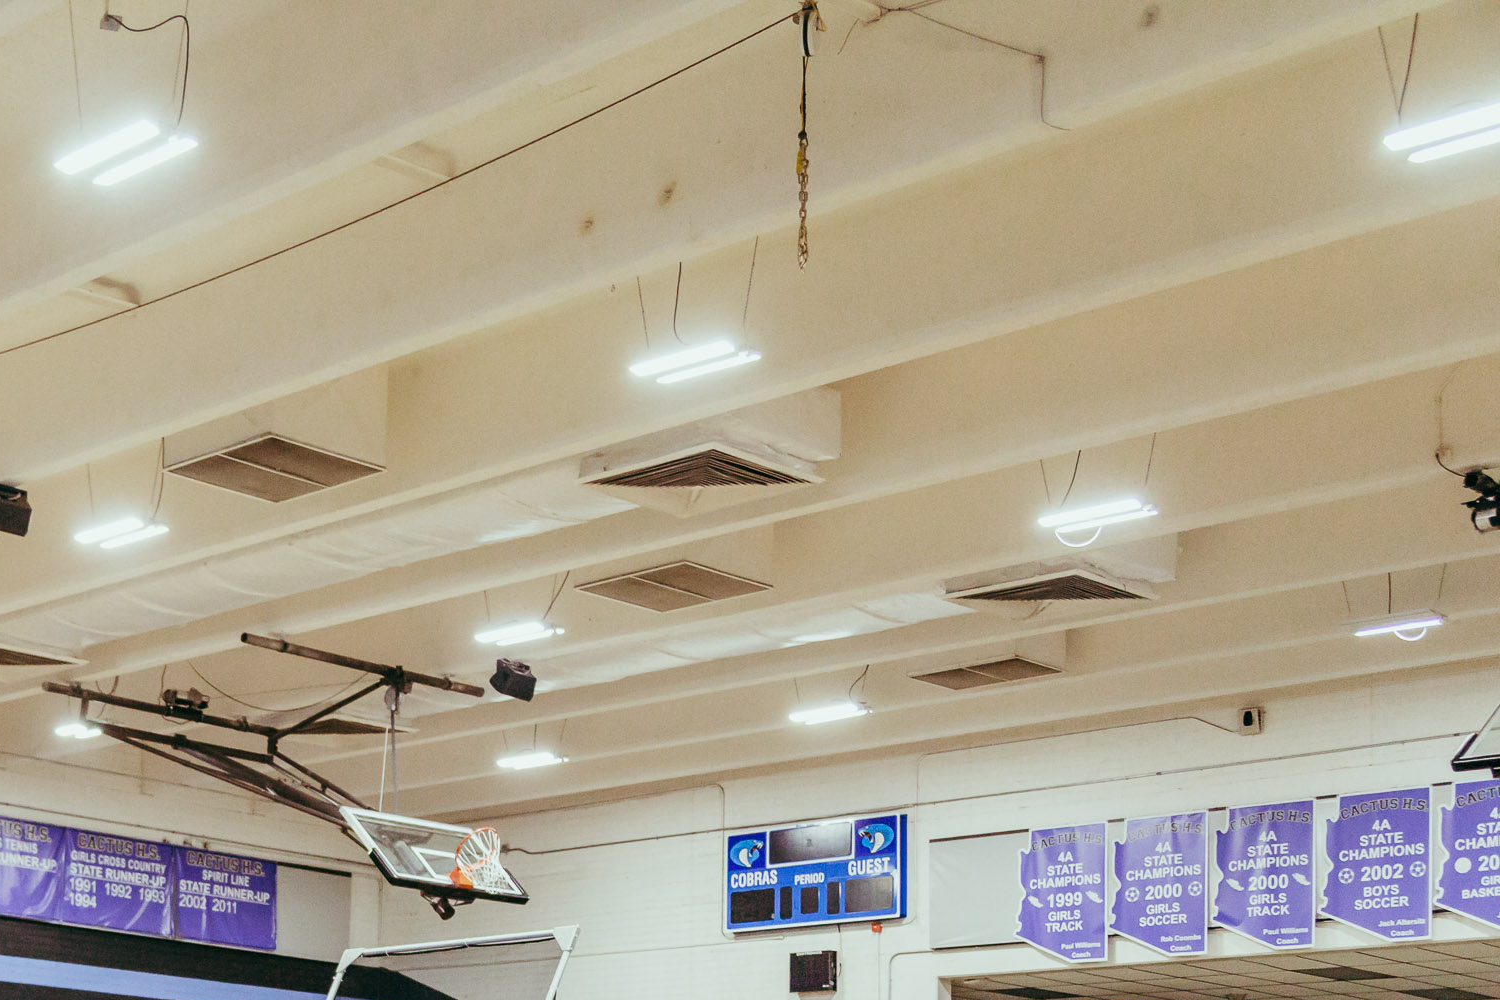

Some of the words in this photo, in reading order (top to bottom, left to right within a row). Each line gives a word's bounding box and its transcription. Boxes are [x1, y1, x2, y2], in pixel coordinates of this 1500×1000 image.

[1341, 798, 1398, 820] CACTUS
[1403, 798, 1429, 812] H.S.
[1490, 807, 1500, 819] 4
[1230, 811, 1284, 831] CACTUS
[1288, 811, 1312, 825] H.S.
[1372, 819, 1391, 831] 4A
[26, 826, 52, 842] H.S.
[1032, 833, 1079, 851] CACTUS
[1259, 831, 1277, 842] 4A
[1359, 832, 1404, 847] STATE
[5, 838, 38, 855] TENNIS
[77, 834, 133, 857] CACTUS
[135, 844, 161, 861] H.S.
[1155, 842, 1172, 853] 4A
[1248, 843, 1289, 857] STATE
[1339, 843, 1425, 862] CHAMPIONS
[70, 850, 96, 864] GIRLS
[98, 855, 126, 869] CROSS
[128, 860, 166, 874] COUNTRY
[187, 851, 239, 873] CACTUS
[242, 862, 266, 877] H.S.
[1058, 851, 1074, 863] 4A
[1144, 854, 1183, 868] STATE
[1229, 854, 1309, 872] CHAMPIONS
[848, 857, 890, 876] GUEST
[1047, 863, 1083, 876] STATE
[1126, 864, 1201, 881] CHAMPIONS
[1360, 864, 1404, 882] 2002
[70, 863, 102, 878] STATE
[106, 869, 166, 888] RUNNER-UP
[202, 871, 228, 884] SPIRIT
[231, 874, 250, 887] LINE
[731, 870, 778, 888] COBRAS
[794, 873, 825, 886] PERIOD
[1030, 873, 1101, 889] CHAMPIONS
[1248, 874, 1289, 891] 2000
[70, 878, 97, 894] 1991
[105, 883, 132, 899] 1992
[139, 888, 165, 904] 1993
[179, 880, 211, 895] STATE
[213, 885, 270, 903] RUNNER-UP
[1145, 883, 1182, 901] 2000
[1249, 893, 1287, 905] GIRLS
[1363, 885, 1400, 897] BOYS
[69, 892, 97, 908] 1994
[212, 899, 237, 914] 2011
[1047, 892, 1083, 908] 1999
[1354, 896, 1409, 911] SOCCER
[1048, 910, 1081, 922] GIRLS
[1146, 902, 1180, 915] GIRLS
[1247, 904, 1290, 917] TRACK
[1045, 921, 1083, 933] TRACK
[1139, 914, 1187, 927] SOCCER
[1263, 928, 1279, 936] Paul
